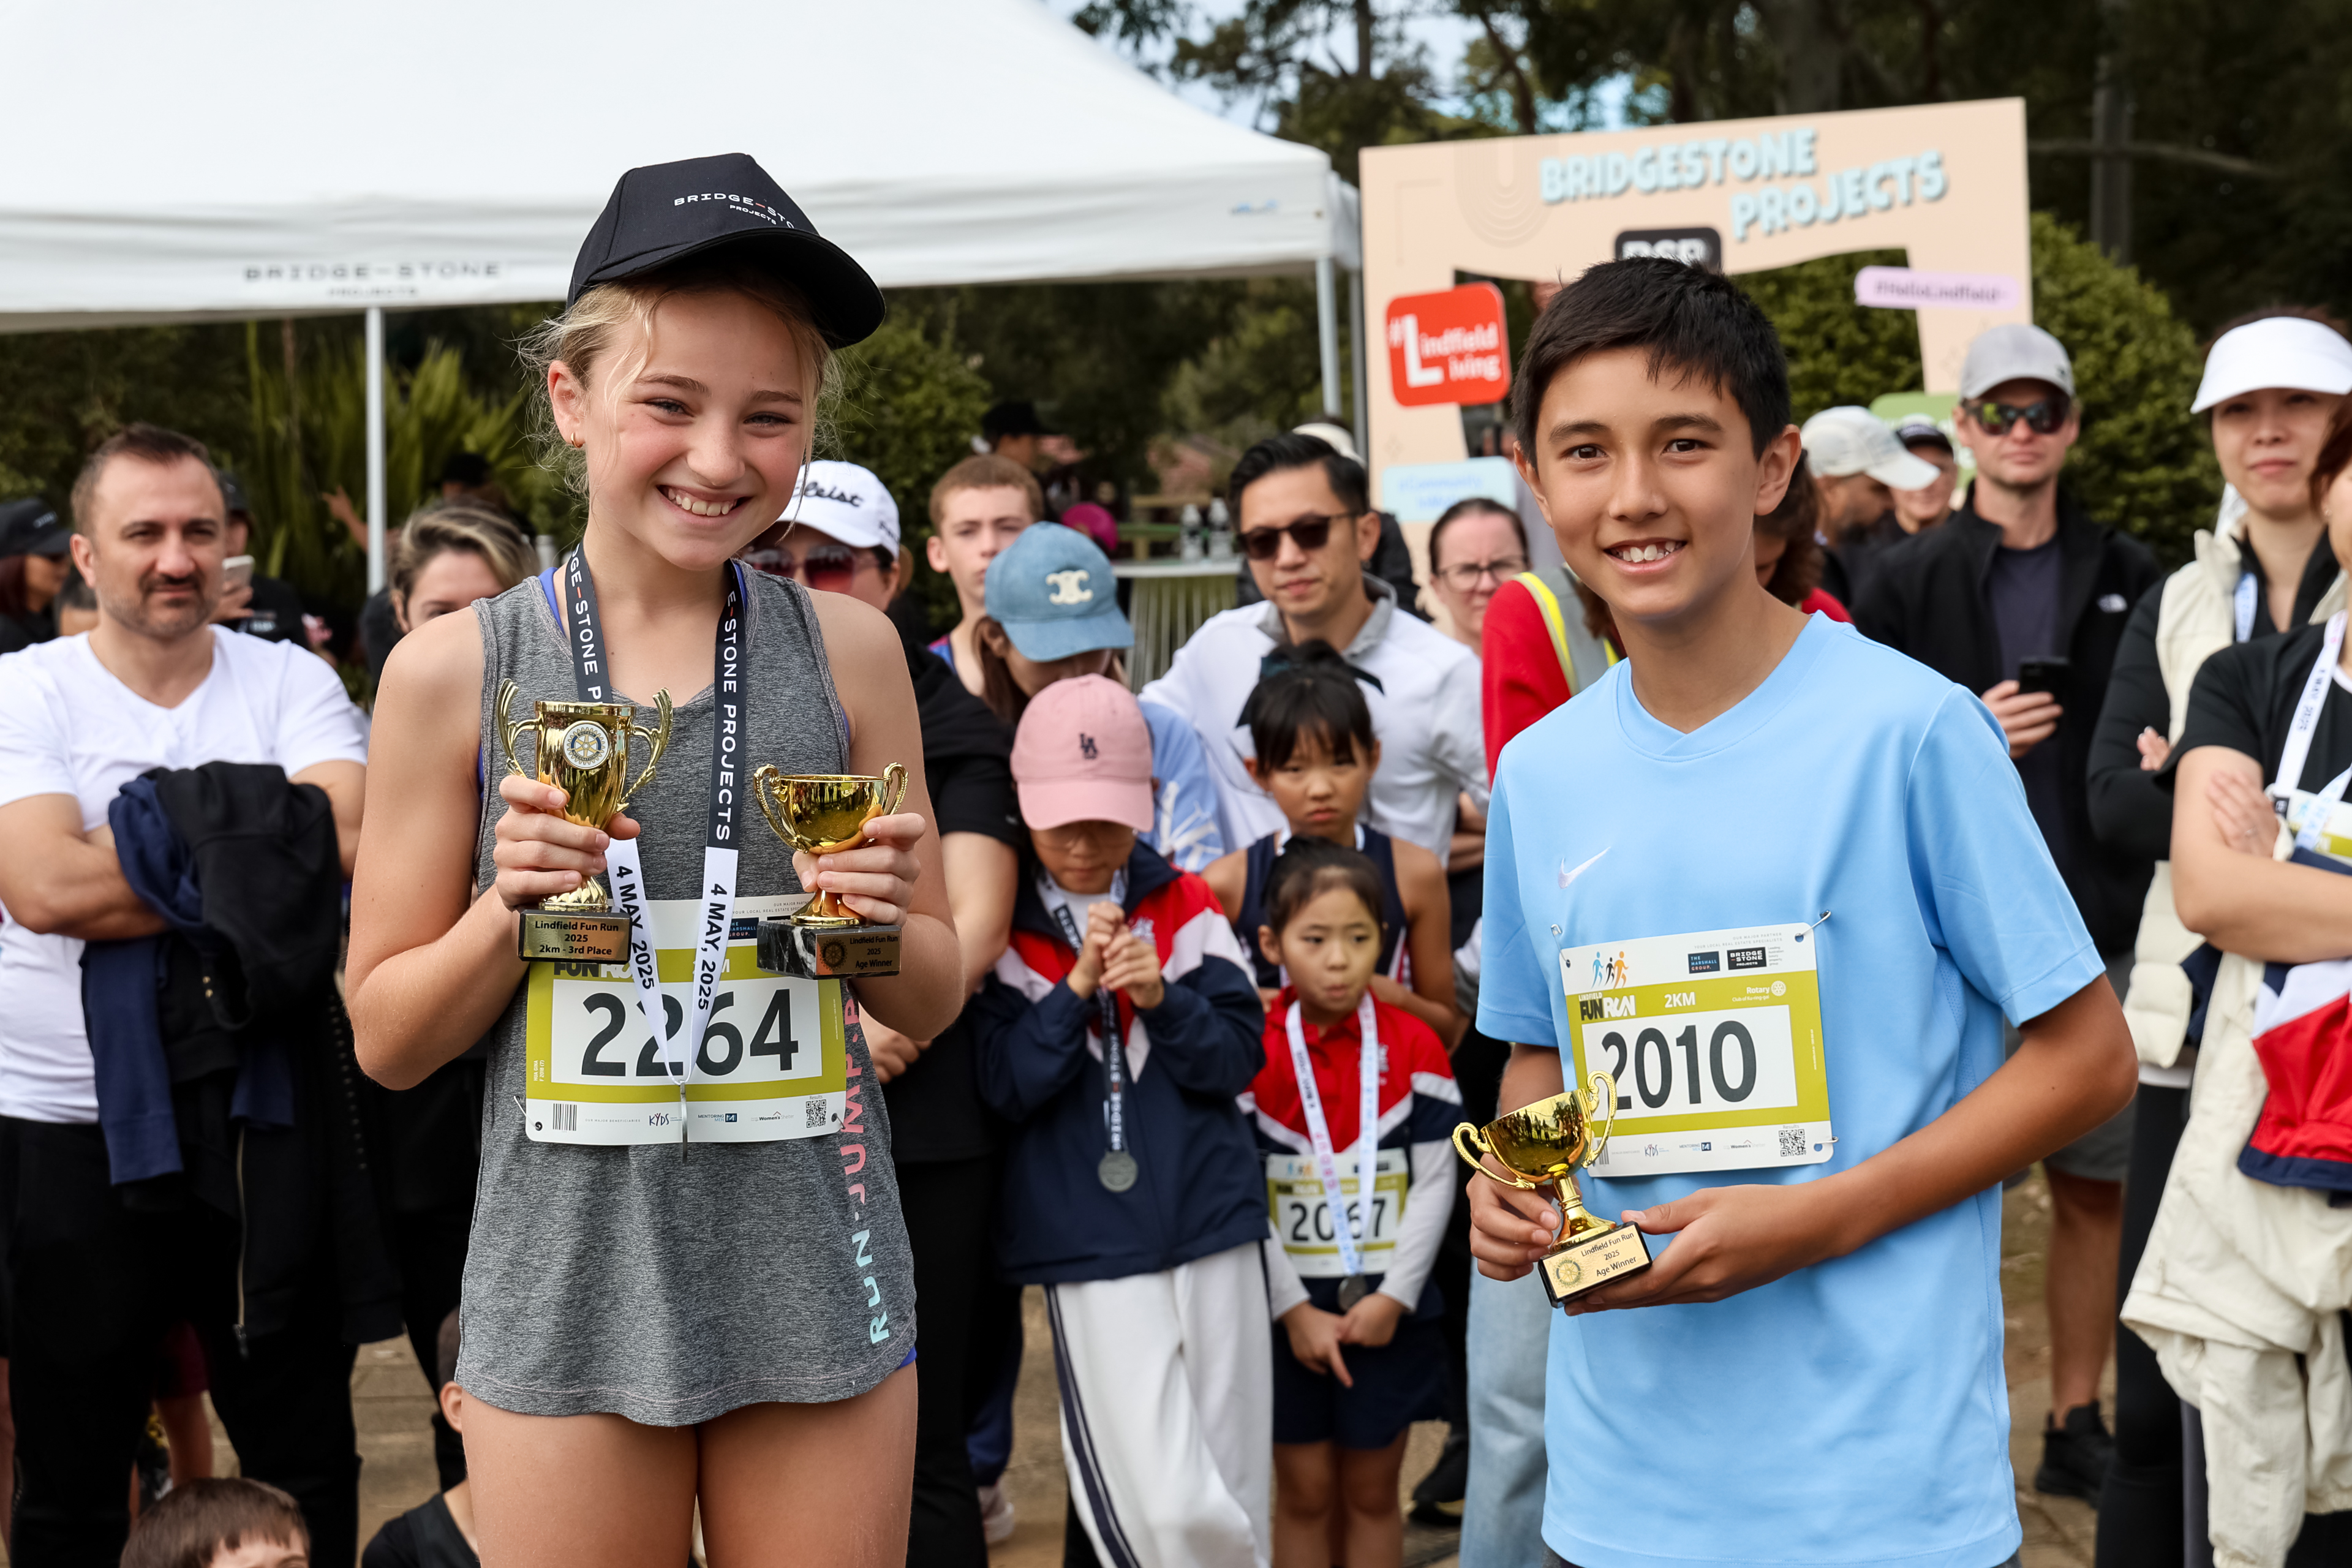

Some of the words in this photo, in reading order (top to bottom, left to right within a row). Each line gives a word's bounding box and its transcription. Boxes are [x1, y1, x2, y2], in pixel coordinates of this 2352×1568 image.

[1539, 127, 1818, 204] BRIDGESTONE
[1730, 149, 1947, 242] PROJECTS
[729, 205, 777, 225] PROJECTS
[245, 262, 502, 281] BRIDGE-STONE
[716, 704, 737, 840] PROJECTS
[616, 865, 633, 878] 4
[710, 883, 728, 896] 4
[619, 883, 644, 930] MAY
[535, 921, 578, 930] Lindfield
[600, 922, 619, 932] Run
[564, 933, 589, 943] 2025
[700, 902, 726, 952] MAY,
[539, 944, 560, 953] 2km
[568, 946, 584, 954] 3rd
[587, 946, 612, 956] Place
[631, 940, 655, 990] 2025
[855, 960, 868, 970] Age
[869, 959, 893, 968] Winner
[697, 960, 717, 1011] 2025
[1578, 992, 1603, 1001] LINDFIELD
[1579, 998, 1604, 1021] FUN
[1602, 995, 1636, 1018] RUN
[1664, 992, 1696, 1008] 2KM
[581, 989, 799, 1077] 2264
[1601, 1020, 1757, 1111] 2010
[1290, 1198, 1387, 1242] 2067
[1581, 1242, 1608, 1257] Lindfield
[1609, 1237, 1621, 1247] Fun
[1621, 1232, 1635, 1242] Run
[1604, 1249, 1620, 1261] 2025
[1596, 1265, 1610, 1277] Age
[1610, 1256, 1637, 1271] Winner
